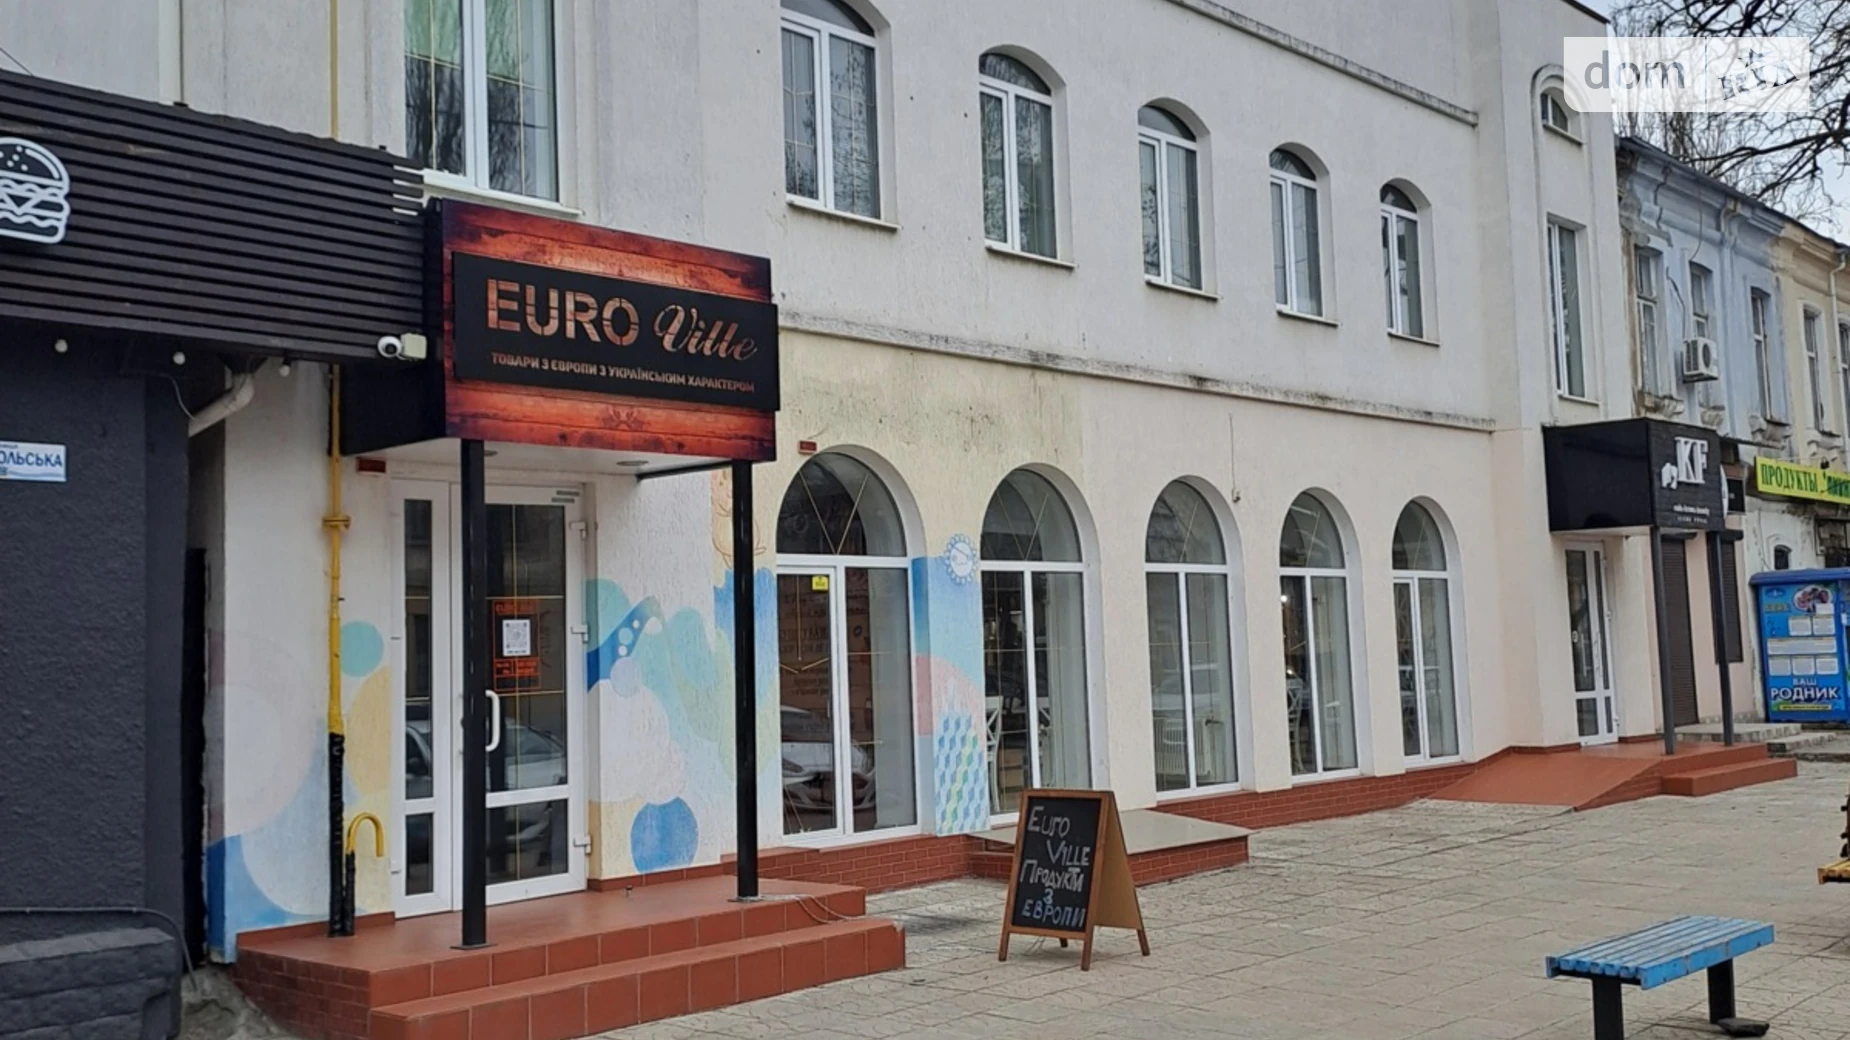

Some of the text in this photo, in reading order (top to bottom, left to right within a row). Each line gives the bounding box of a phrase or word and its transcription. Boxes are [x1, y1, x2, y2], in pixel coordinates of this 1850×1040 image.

[487, 278, 758, 362] EURO Ville
[491, 351, 755, 393] ТОВАРИ З ЄВРОПИ З УКРАЇНСЬКИМ ХАРАКТЕРОМ
[1760, 462, 1819, 493] ПРОДУКТЫ
[1770, 686, 1839, 702] РОДНИК
[1792, 677, 1817, 686] ВАШ
